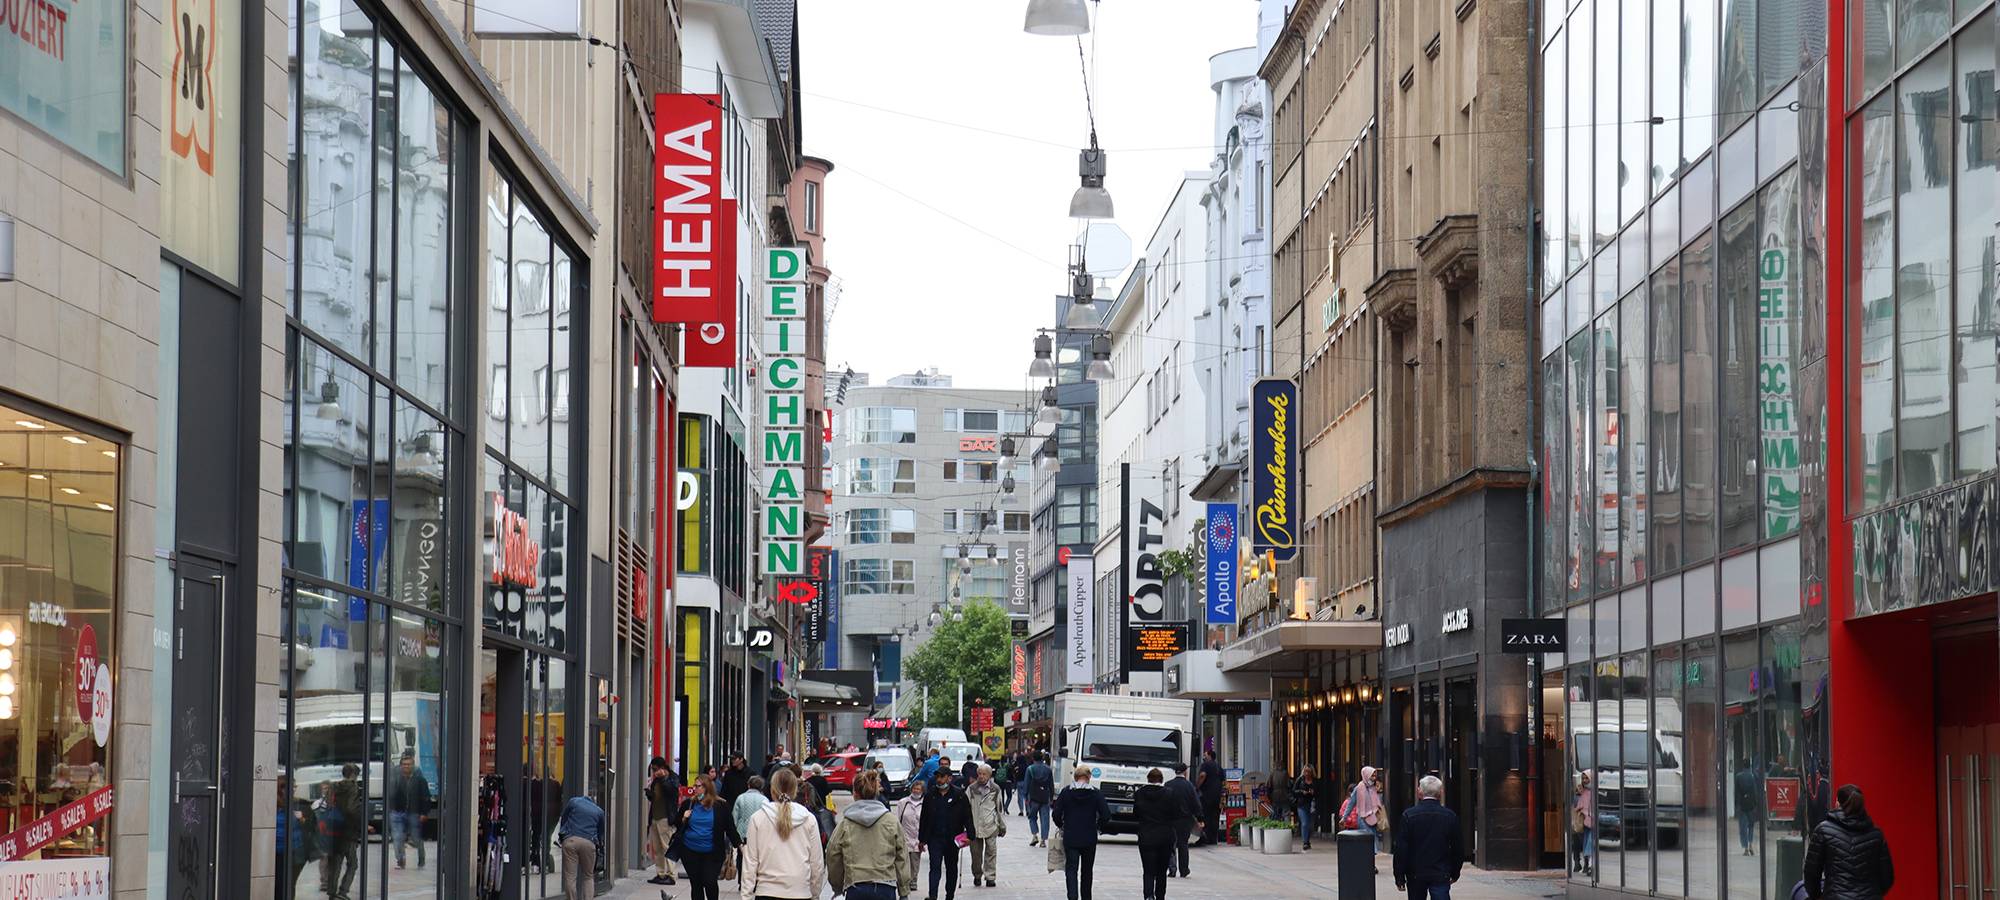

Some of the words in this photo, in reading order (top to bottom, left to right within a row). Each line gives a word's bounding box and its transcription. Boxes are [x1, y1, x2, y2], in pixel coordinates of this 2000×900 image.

[662, 119, 713, 298] HEMA
[765, 249, 802, 573] DEICHMANN
[960, 437, 997, 453] DAK
[1256, 391, 1294, 551] Rüschenbeck
[1214, 561, 1232, 616] Apollo
[750, 630, 773, 647] JD
[1073, 575, 1086, 668] AppelrathCüpper
[1506, 634, 1561, 645] ZARA
[25, 820, 54, 849] %SALE%
[60, 802, 87, 831] %SALE%
